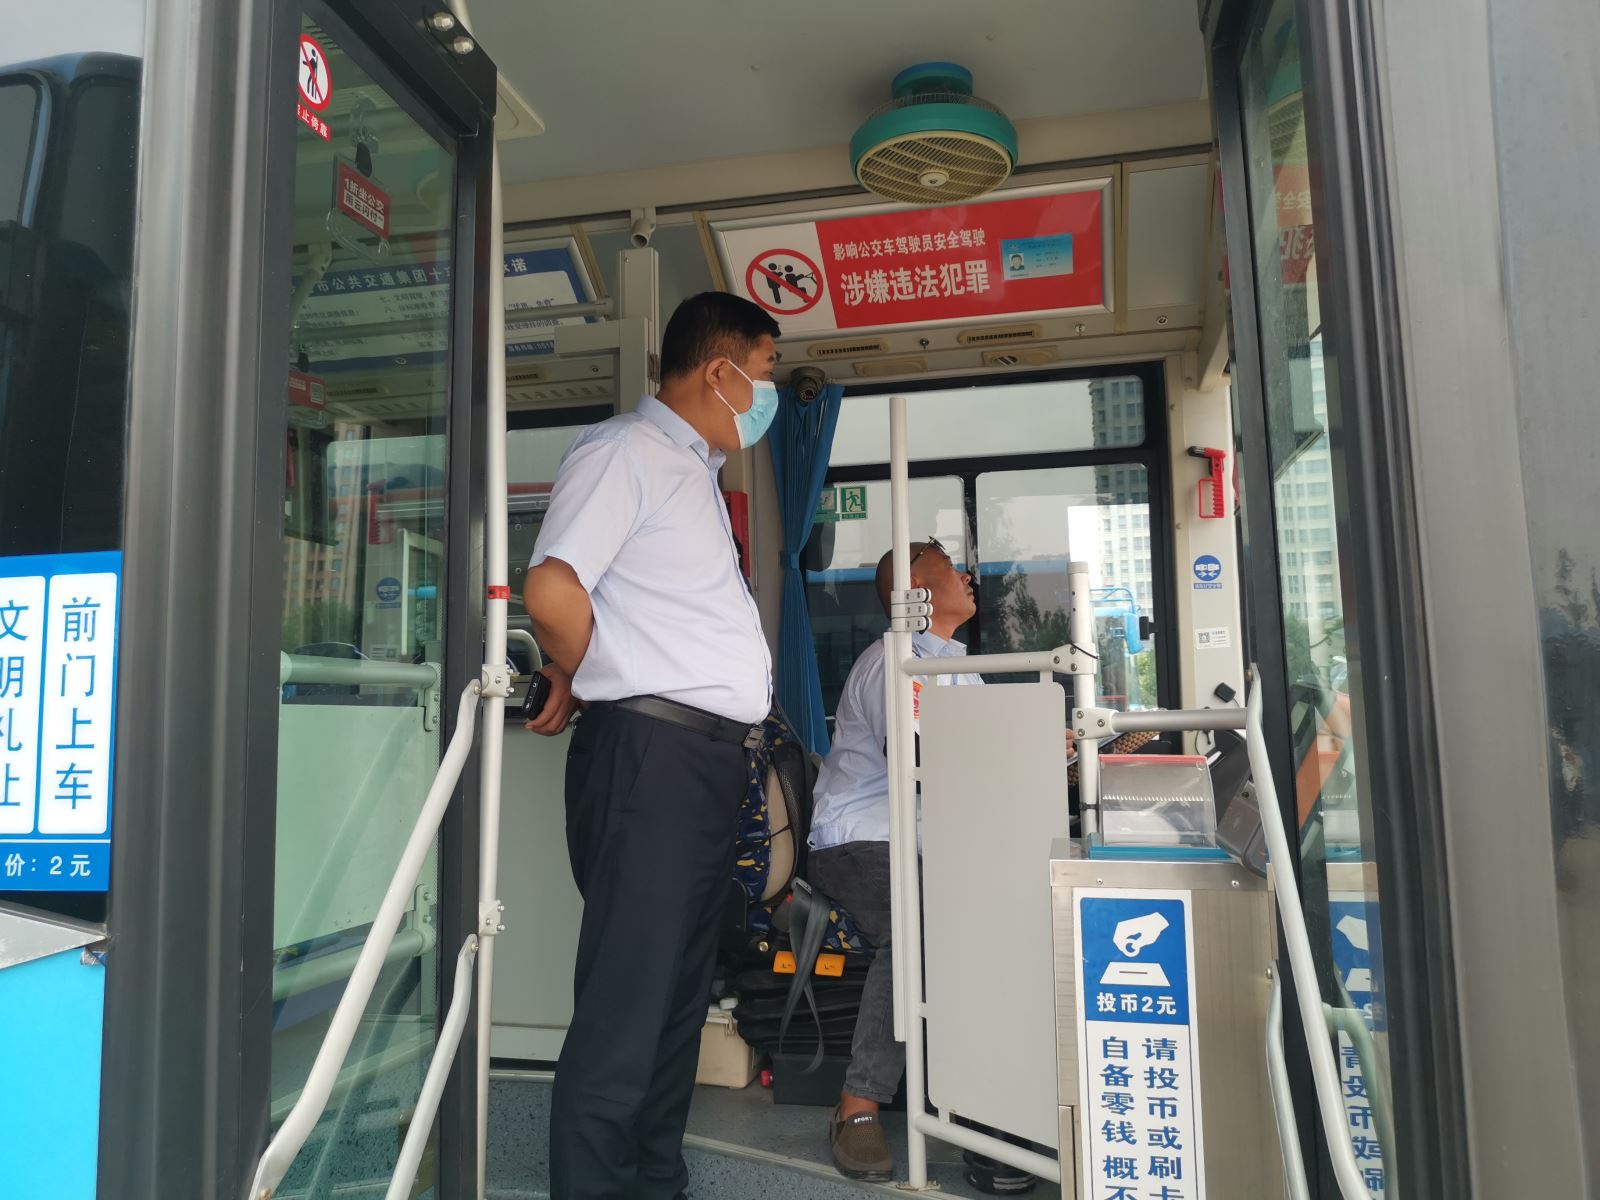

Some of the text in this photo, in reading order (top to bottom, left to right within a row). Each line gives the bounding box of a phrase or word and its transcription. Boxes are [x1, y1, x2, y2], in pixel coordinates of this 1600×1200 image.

[297, 104, 328, 138] 止倚靠
[833, 228, 986, 261] 影响公交车驾驶员安全驾驶
[840, 259, 990, 306] 涉嫌违法犯罪
[55, 596, 101, 810] 前门上车
[1097, 992, 1177, 1015] 投币2元
